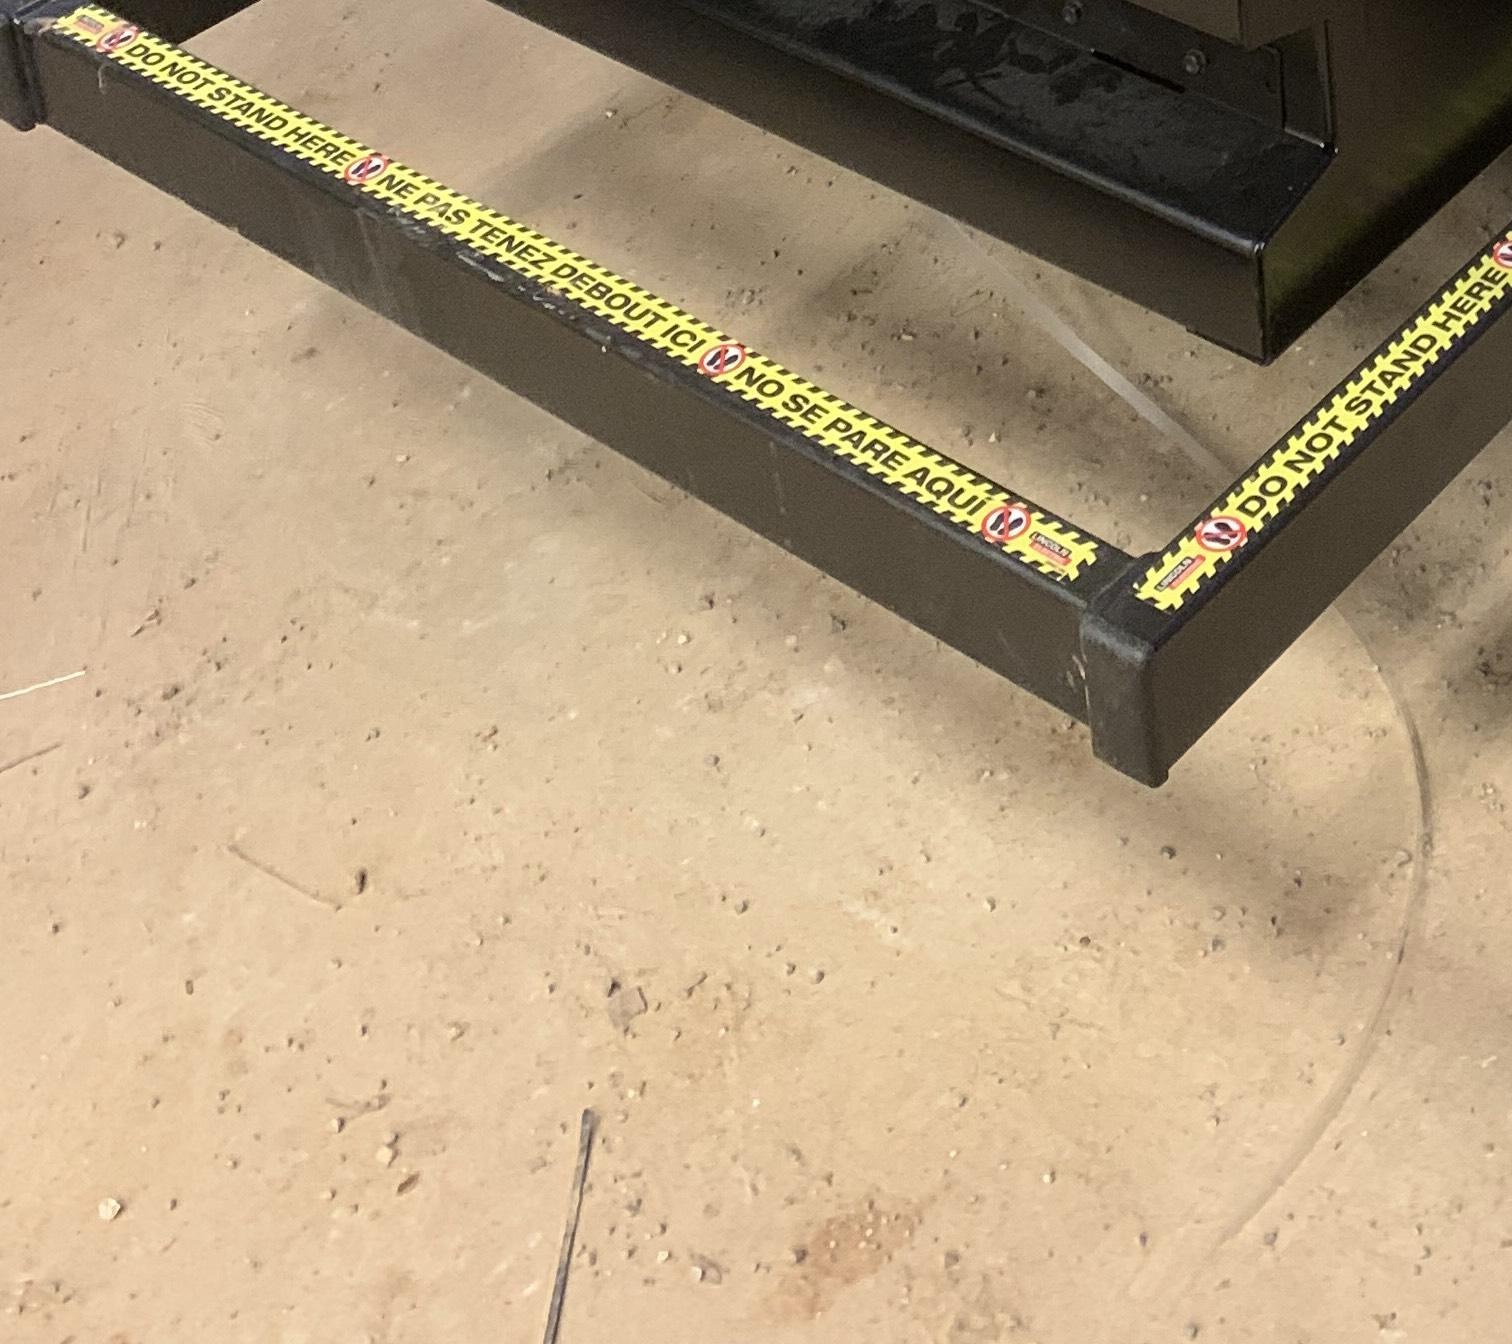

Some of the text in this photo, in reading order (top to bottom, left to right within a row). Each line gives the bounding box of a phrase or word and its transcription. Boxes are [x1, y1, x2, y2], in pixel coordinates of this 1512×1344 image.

[125, 42, 358, 167] DO NOT STAND HERE
[376, 173, 707, 354] NE PAS TENEZ DEBOUT ICI
[734, 365, 785, 399] NO
[781, 393, 830, 425] SE
[823, 417, 911, 471] PARE
[1237, 267, 1508, 519] DO NOT STAND HERE
